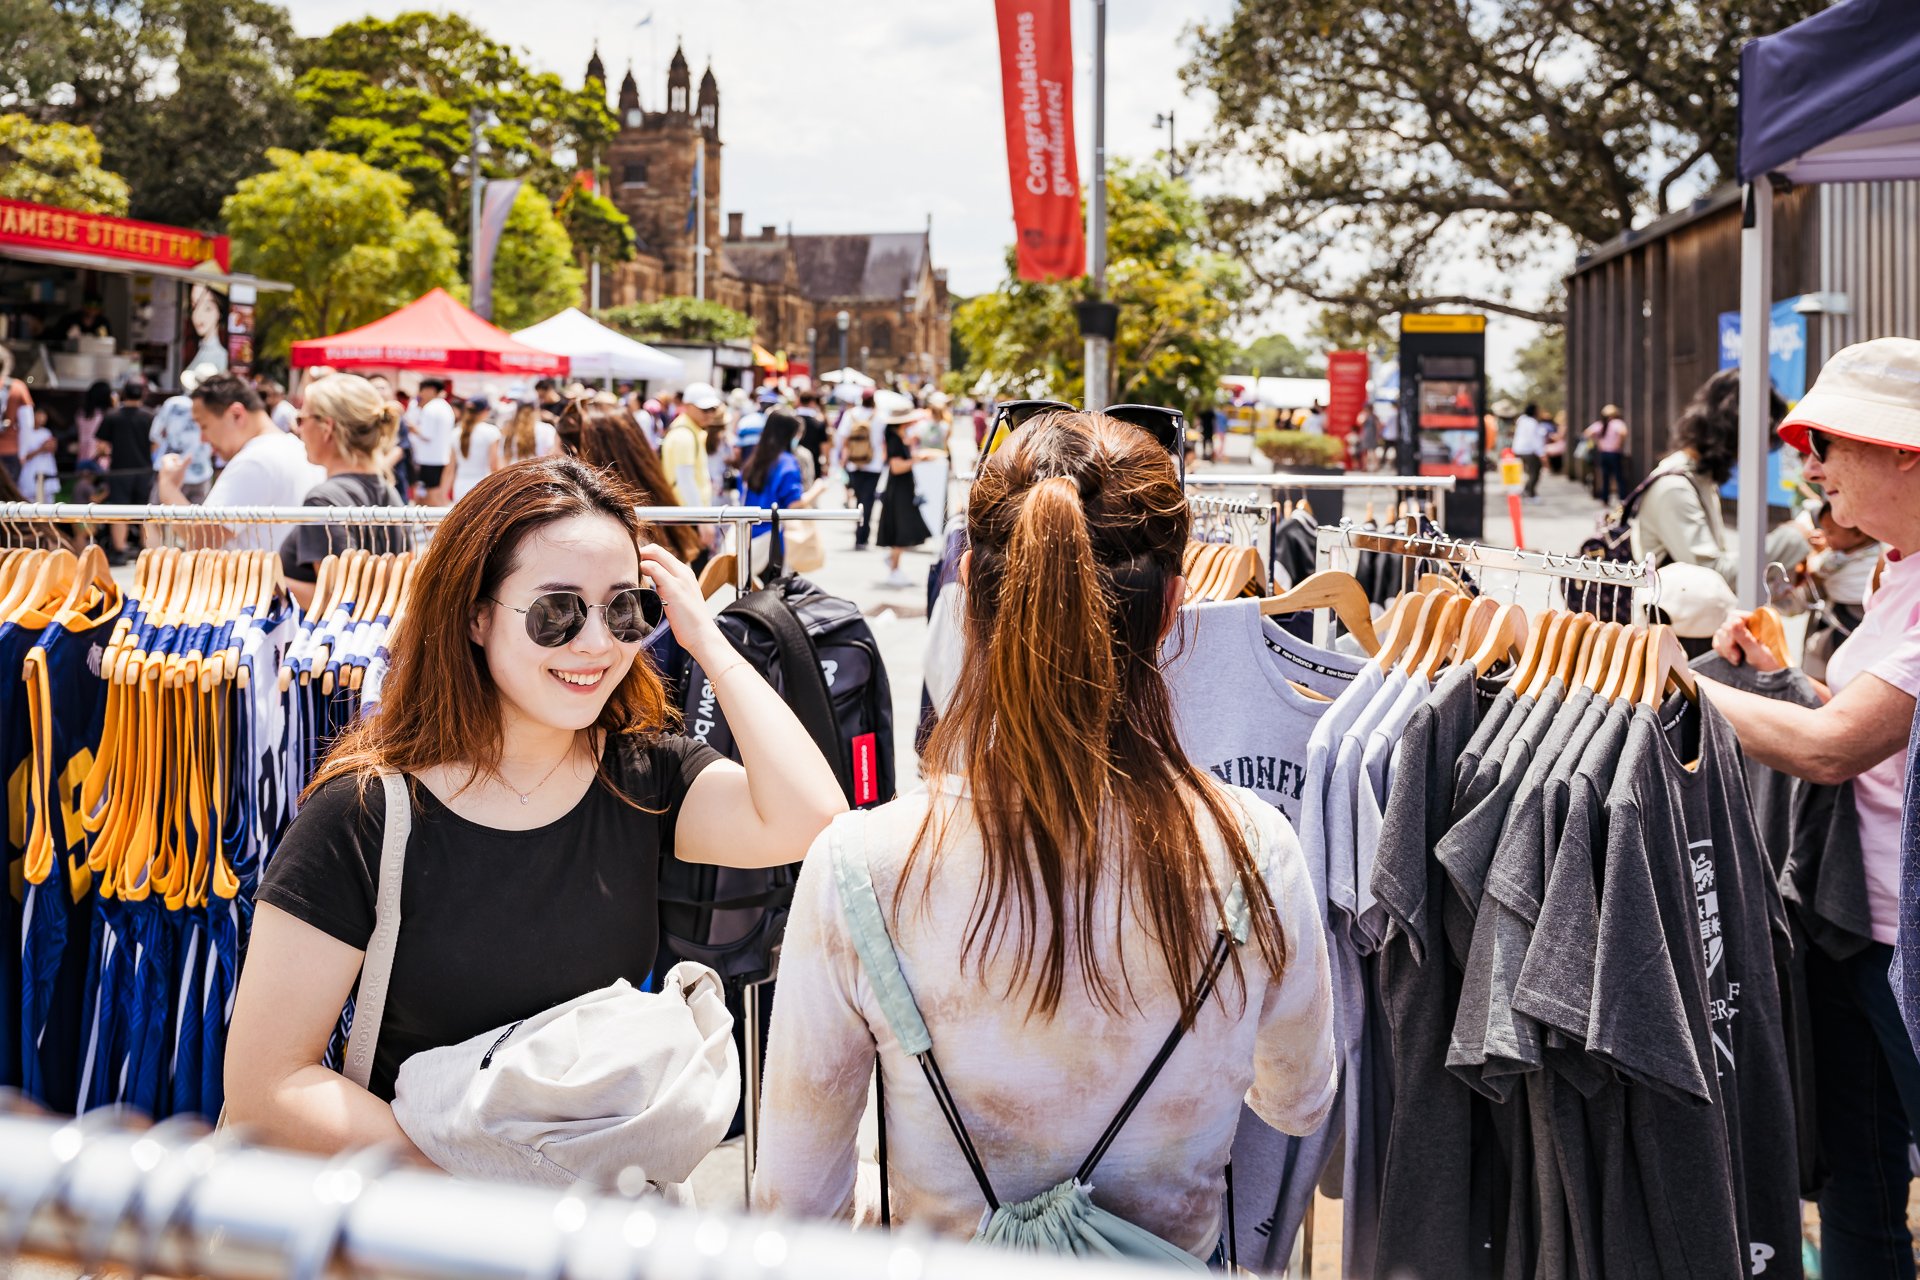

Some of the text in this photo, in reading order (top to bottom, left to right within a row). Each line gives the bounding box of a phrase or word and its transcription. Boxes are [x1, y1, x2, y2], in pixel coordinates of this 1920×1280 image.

[1015, 12, 1049, 196] Congratulations
[0, 206, 79, 242] AMESE
[87, 219, 161, 256] STREET
[1210, 755, 1307, 801] YDNEY
